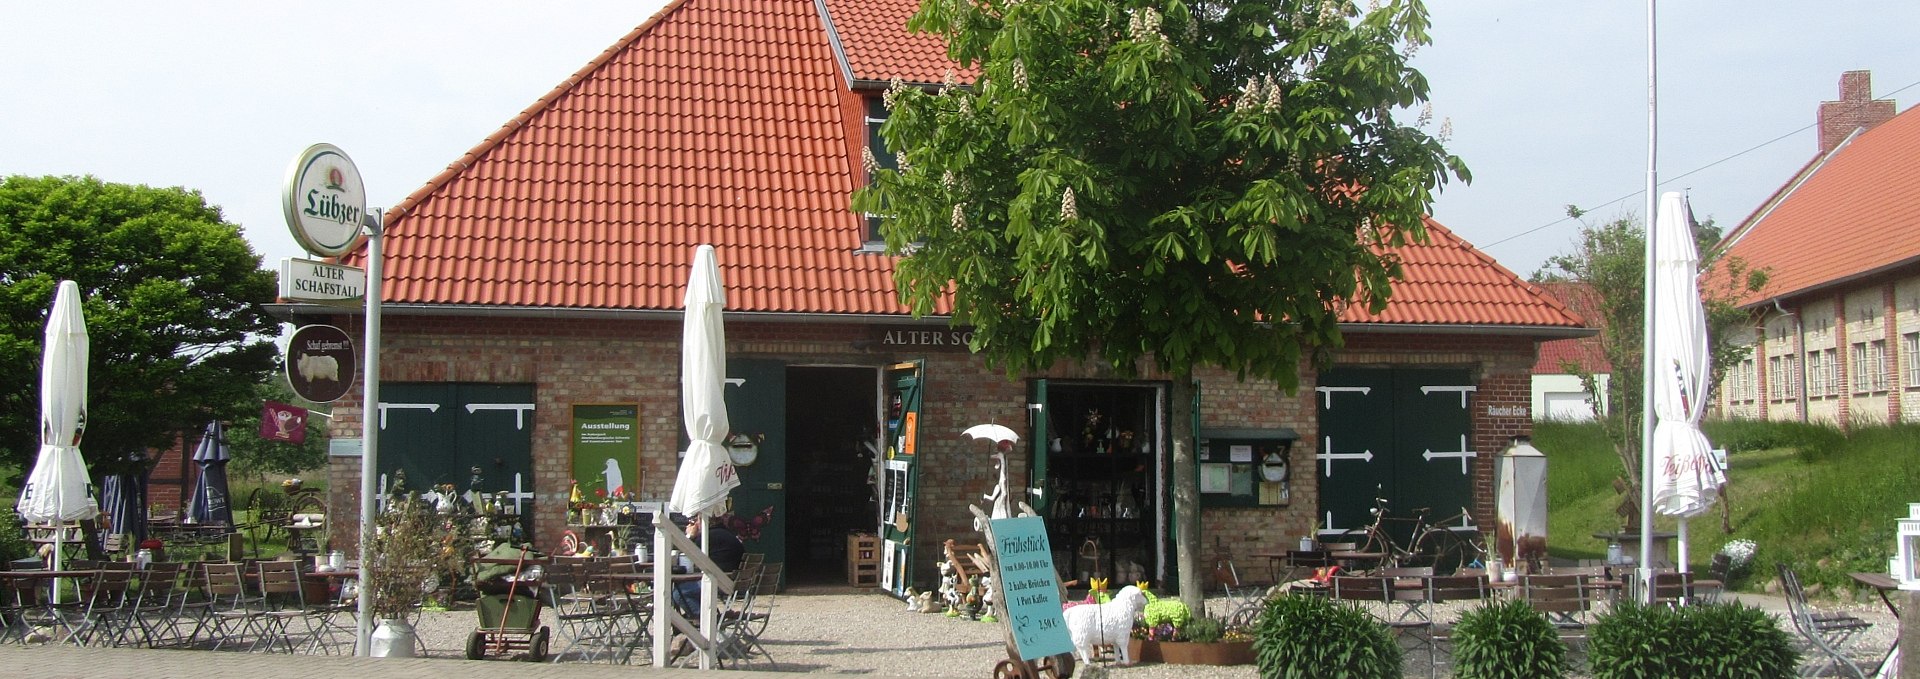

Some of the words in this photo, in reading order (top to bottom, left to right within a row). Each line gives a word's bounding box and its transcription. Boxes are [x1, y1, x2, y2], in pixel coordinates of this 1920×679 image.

[303, 188, 360, 225] Lübzer
[312, 265, 345, 281] ALTER
[306, 339, 322, 350] Schaf
[882, 330, 944, 345] ALTER
[1512, 404, 1527, 416] Ecke
[581, 422, 630, 431] Ausstellung
[1001, 535, 1046, 556] Frühstück
[1004, 564, 1014, 572] von
[1039, 559, 1049, 568] Uhr
[1008, 581, 1013, 592] 2
[1013, 580, 1028, 591] halbe
[1027, 578, 1051, 589] Brötchen
[1016, 596, 1020, 607] 1
[1020, 595, 1032, 606] Pott
[1031, 593, 1049, 604] Kaffee
